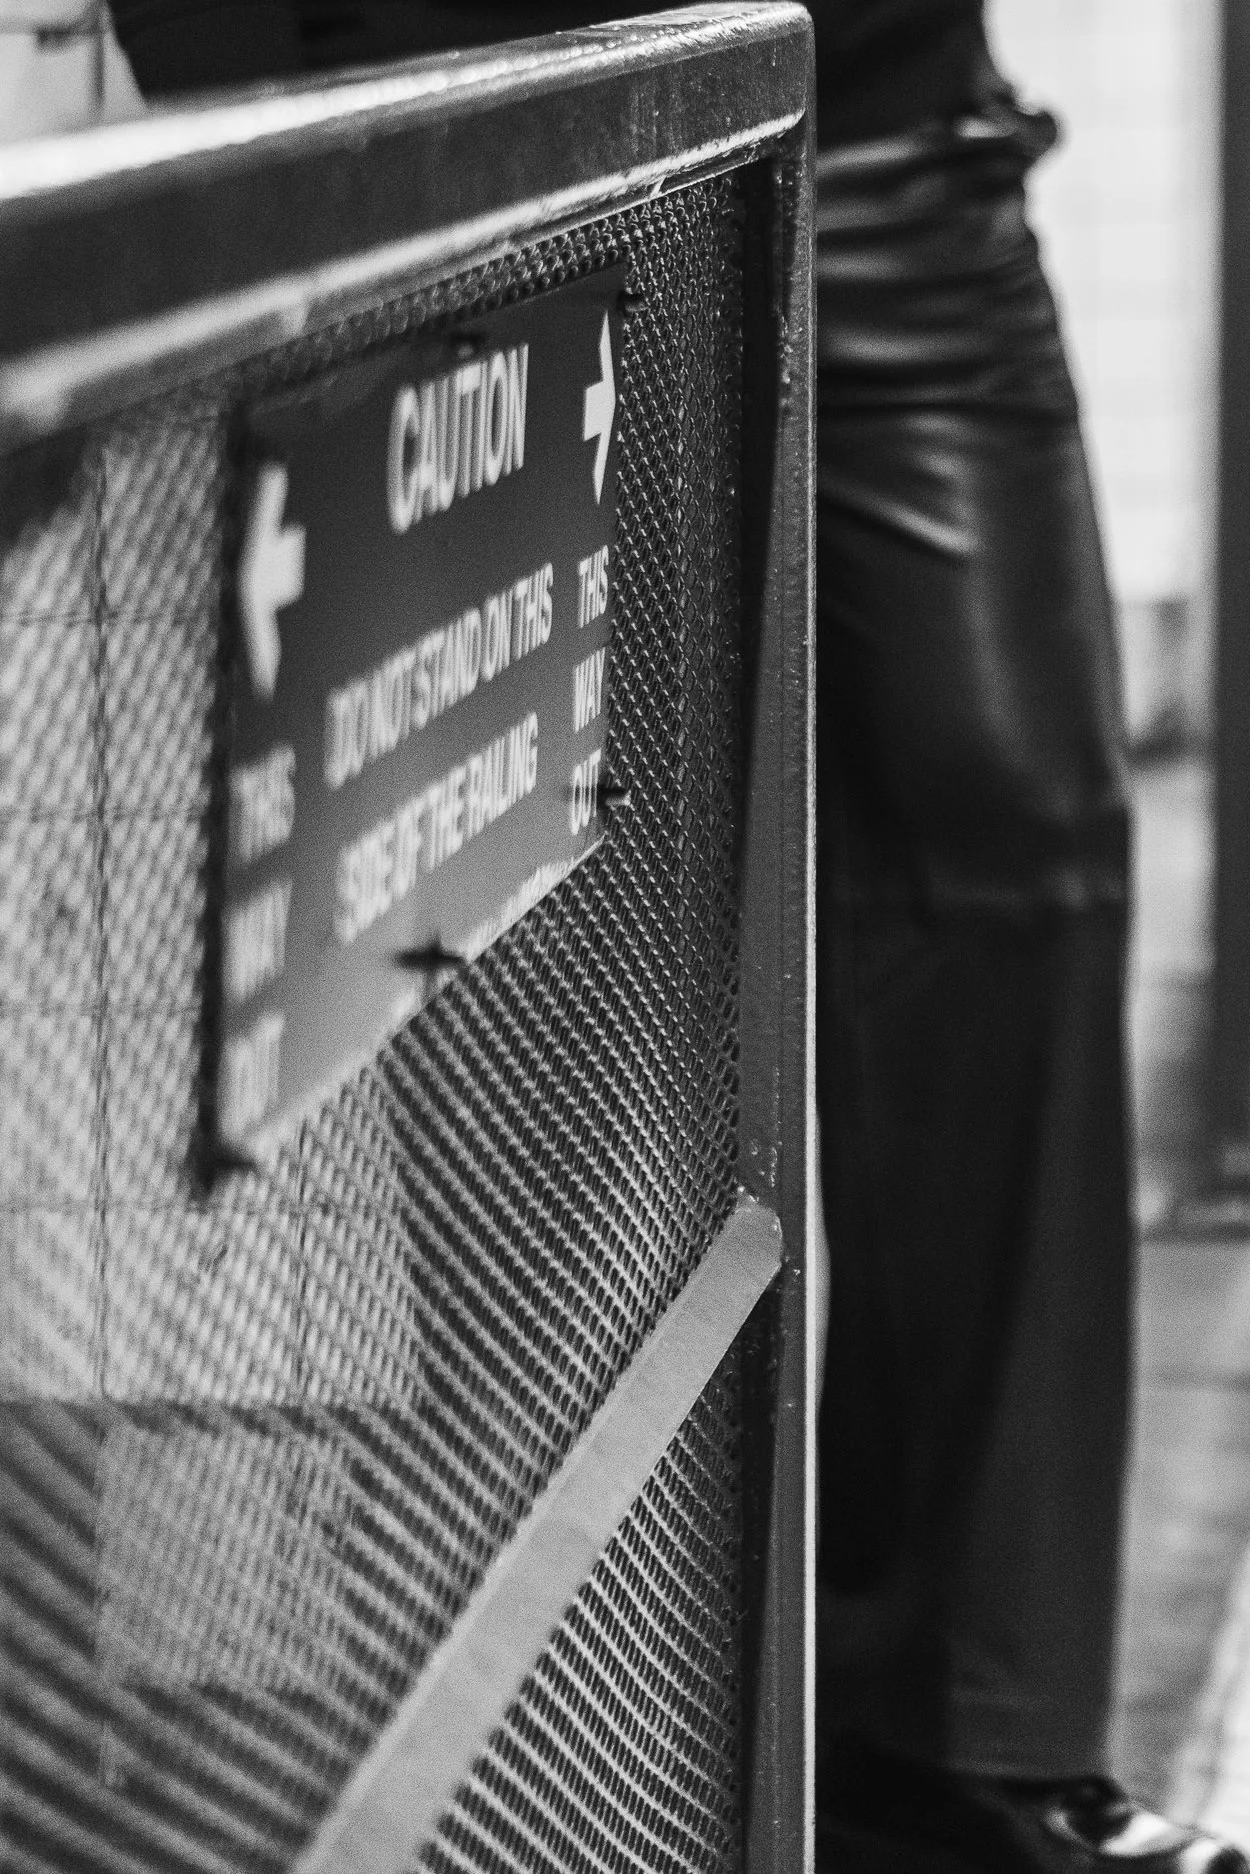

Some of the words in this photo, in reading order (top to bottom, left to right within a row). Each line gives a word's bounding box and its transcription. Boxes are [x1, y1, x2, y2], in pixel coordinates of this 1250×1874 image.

[387, 342, 529, 535] CAUTION
[579, 544, 609, 628] THIS
[324, 679, 368, 790] DO
[368, 647, 416, 760] NOT
[412, 607, 481, 729] STAND
[482, 589, 513, 682] ON
[514, 562, 554, 661] THIS
[573, 646, 606, 733] WAY
[425, 765, 467, 874] THE
[466, 711, 539, 841] RAILING
[571, 747, 602, 837] OUT
